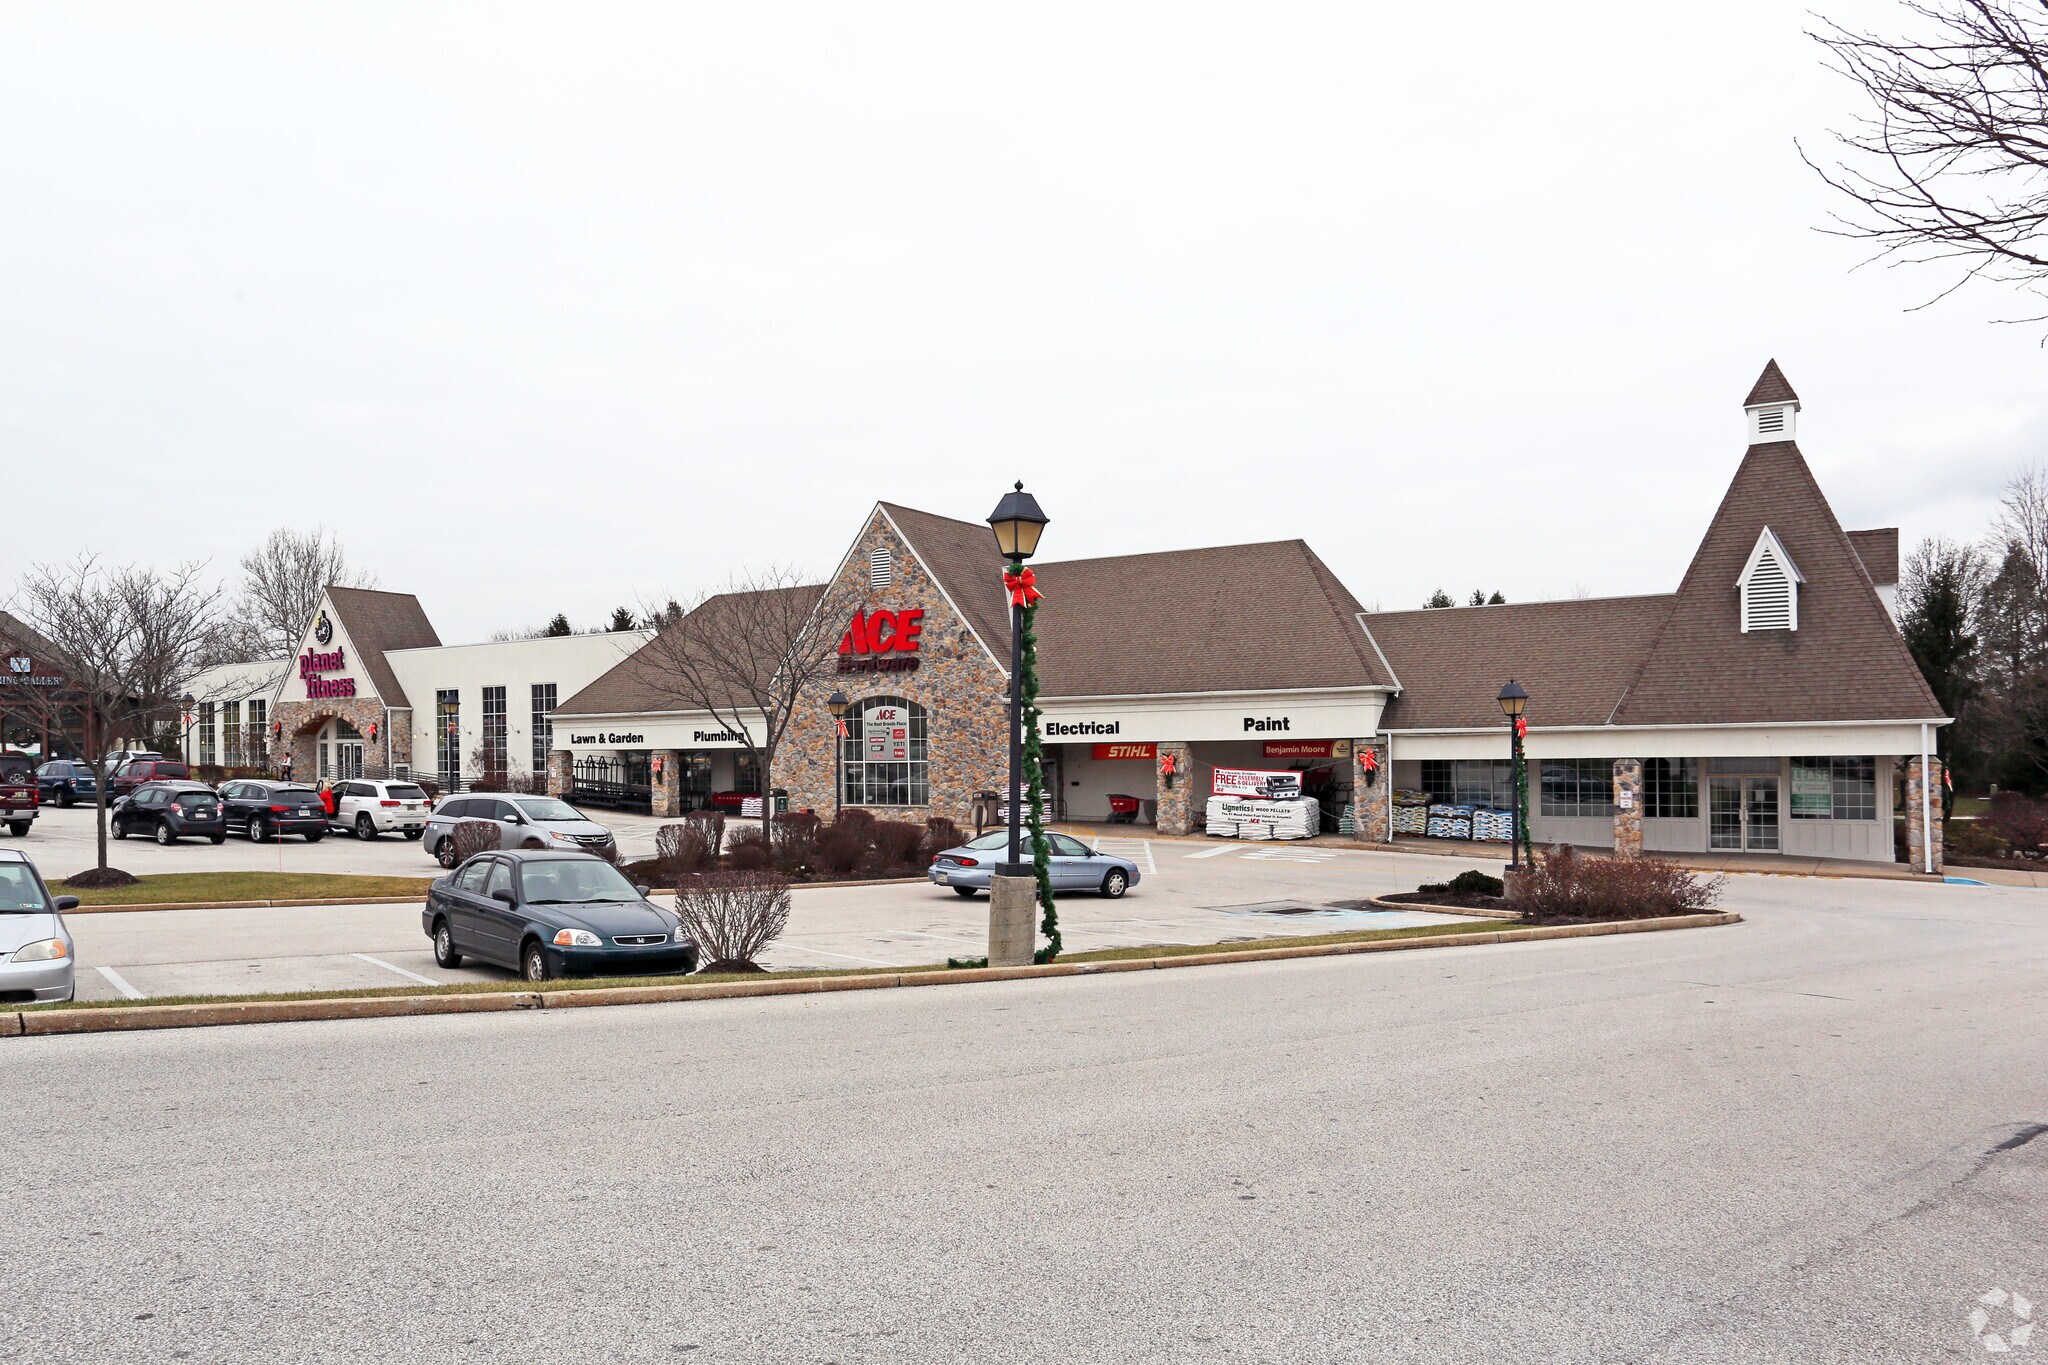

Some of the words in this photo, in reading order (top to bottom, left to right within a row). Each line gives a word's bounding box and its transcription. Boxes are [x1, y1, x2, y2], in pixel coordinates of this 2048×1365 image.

[837, 609, 924, 654] ACE
[299, 646, 345, 679] planet
[306, 674, 356, 698] fitness
[876, 709, 896, 720] ACE
[1046, 721, 1120, 735] Electrical
[1243, 717, 1290, 731] Paint
[571, 734, 596, 744] Lawn
[598, 733, 606, 743] &
[608, 733, 644, 743] Garden
[694, 730, 745, 743] Plumbing
[1108, 746, 1150, 758] STIHL
[1265, 746, 1300, 755] Benjamin
[1215, 774, 1237, 785] FREE
[1793, 769, 1829, 781] LEASE
